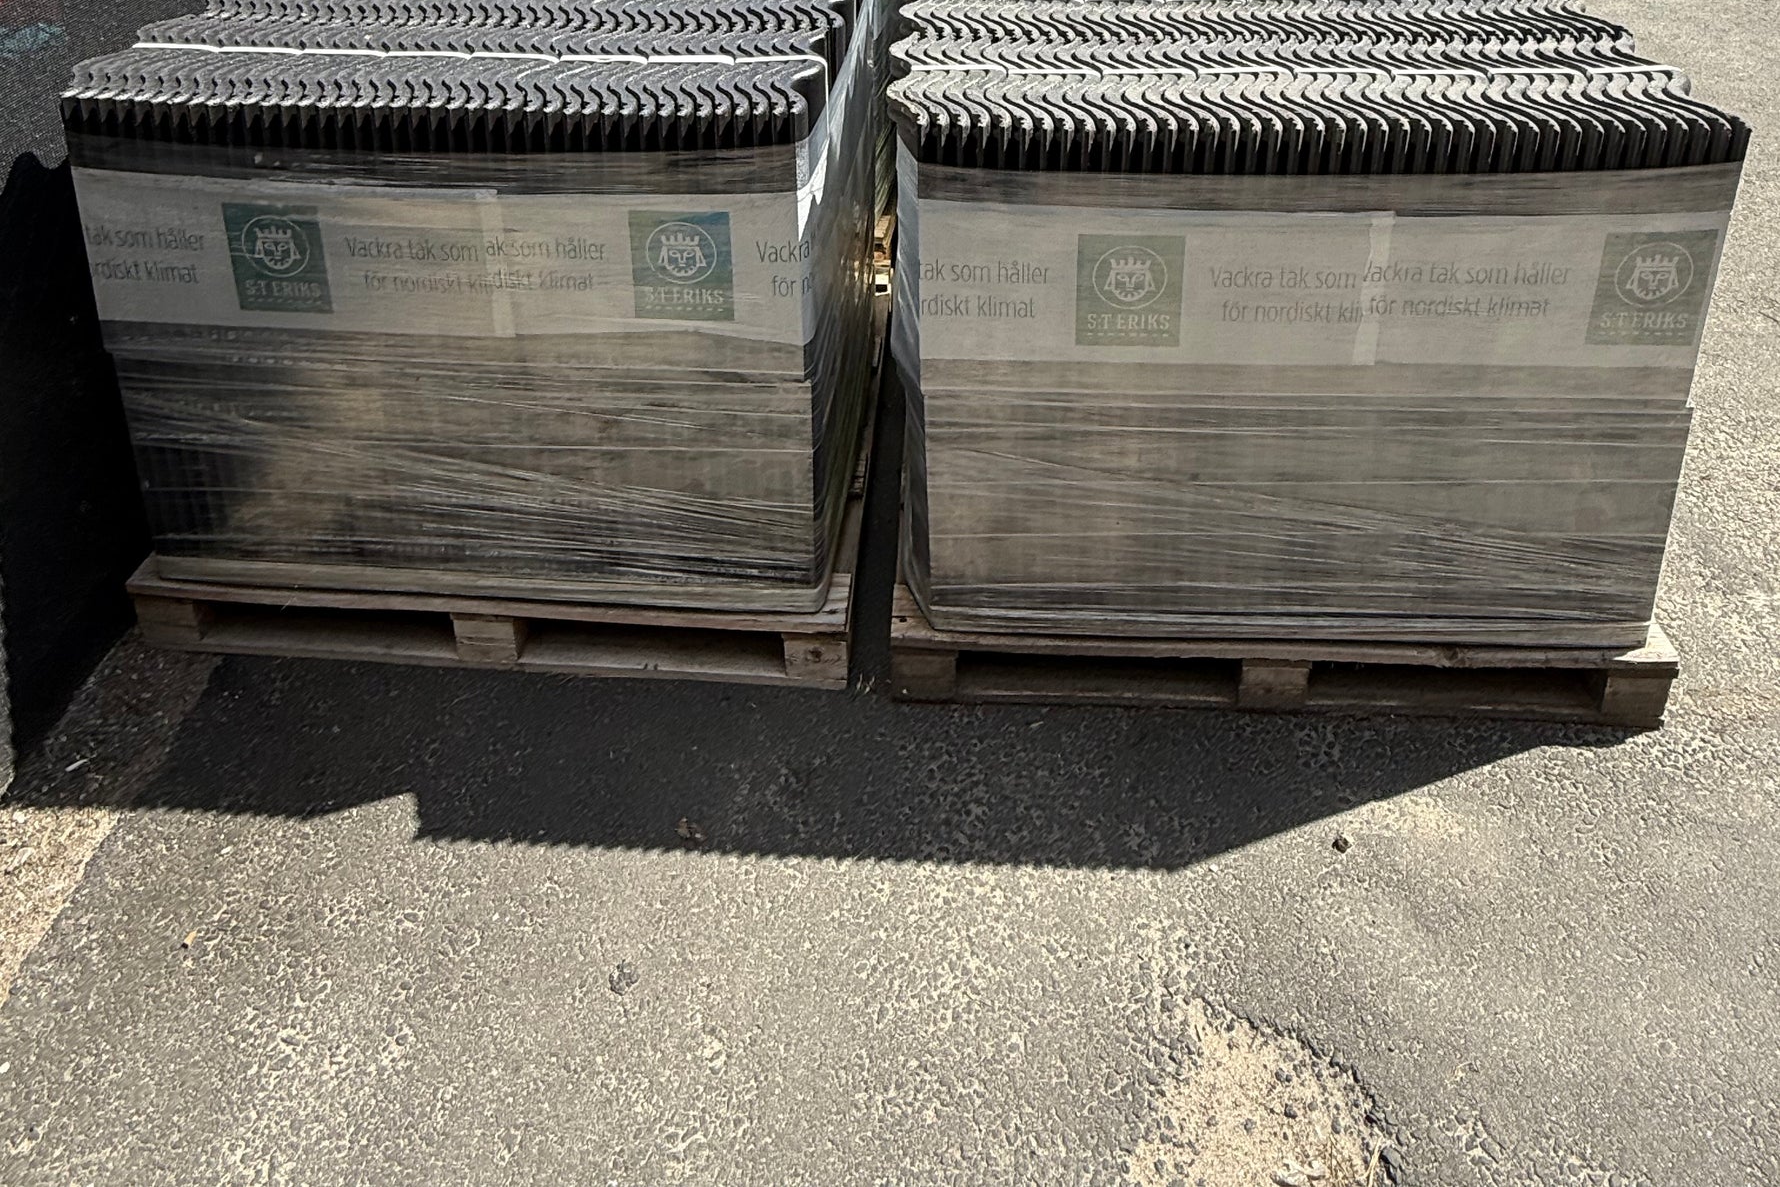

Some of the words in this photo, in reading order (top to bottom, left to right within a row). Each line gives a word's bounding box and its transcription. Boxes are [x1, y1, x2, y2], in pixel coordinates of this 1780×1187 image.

[114, 230, 153, 248] som
[155, 227, 204, 251] håller
[344, 237, 403, 259] Vackra
[408, 238, 436, 261] tak
[440, 242, 479, 262] som
[510, 240, 550, 259] som
[555, 236, 605, 260] håller
[756, 240, 810, 263] Vackra
[143, 260, 199, 284] klimat
[364, 271, 387, 291] för
[538, 269, 594, 291] klimat
[951, 264, 991, 282] som
[998, 259, 1049, 284] håller
[1210, 266, 1273, 288] Vackra
[1279, 267, 1311, 289] tak
[1315, 271, 1356, 289] som
[1429, 263, 1460, 284] tak
[1464, 265, 1507, 285] som
[1513, 261, 1574, 286] håller
[271, 281, 321, 298] ERIKS
[671, 288, 724, 304] ERIKS
[772, 275, 796, 297] för
[921, 294, 971, 316] rdiskt
[977, 295, 1035, 318] klimat
[1222, 300, 1252, 322] för
[1254, 301, 1331, 323] nordiskt
[1370, 294, 1397, 315] för
[1402, 297, 1481, 317] nordiskt
[1486, 297, 1551, 317] klimat
[1117, 314, 1170, 330] ERIKS
[1631, 311, 1688, 329] ERIKS
